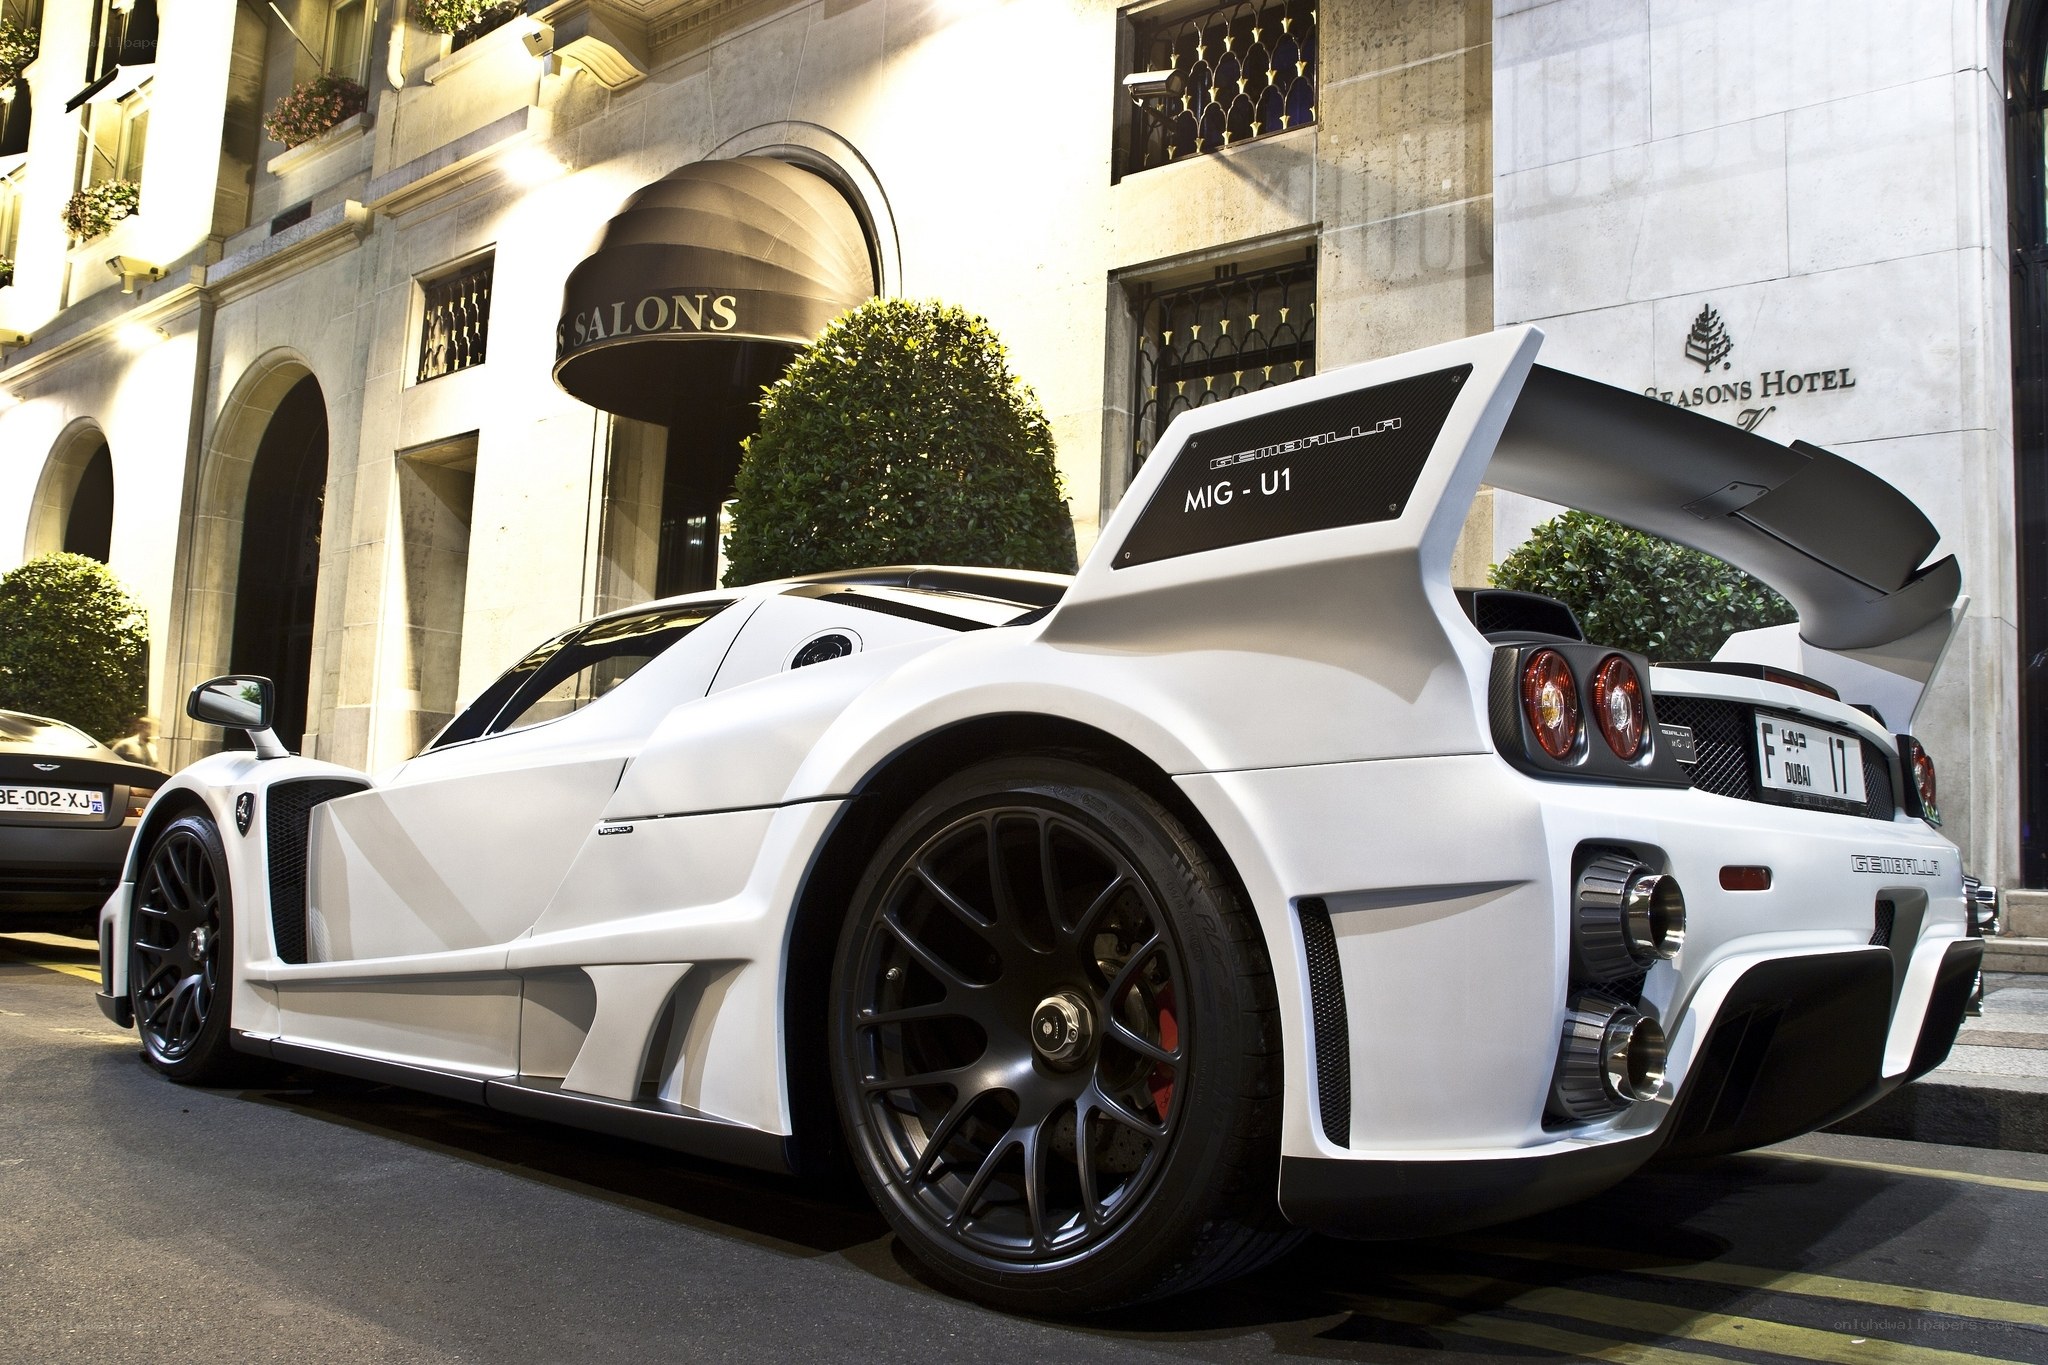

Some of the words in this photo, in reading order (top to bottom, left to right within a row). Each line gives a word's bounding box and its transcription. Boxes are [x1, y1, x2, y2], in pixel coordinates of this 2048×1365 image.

[573, 294, 737, 347] SALONS
[1760, 368, 1856, 398] HOTEL
[1209, 417, 1402, 470] GEMBALLA
[1184, 480, 1233, 513] MIG
[1261, 467, 1290, 496] U1
[1761, 722, 1775, 779] F
[1785, 761, 1811, 787] DUBAI
[1851, 854, 1941, 876] GEMBALLA
